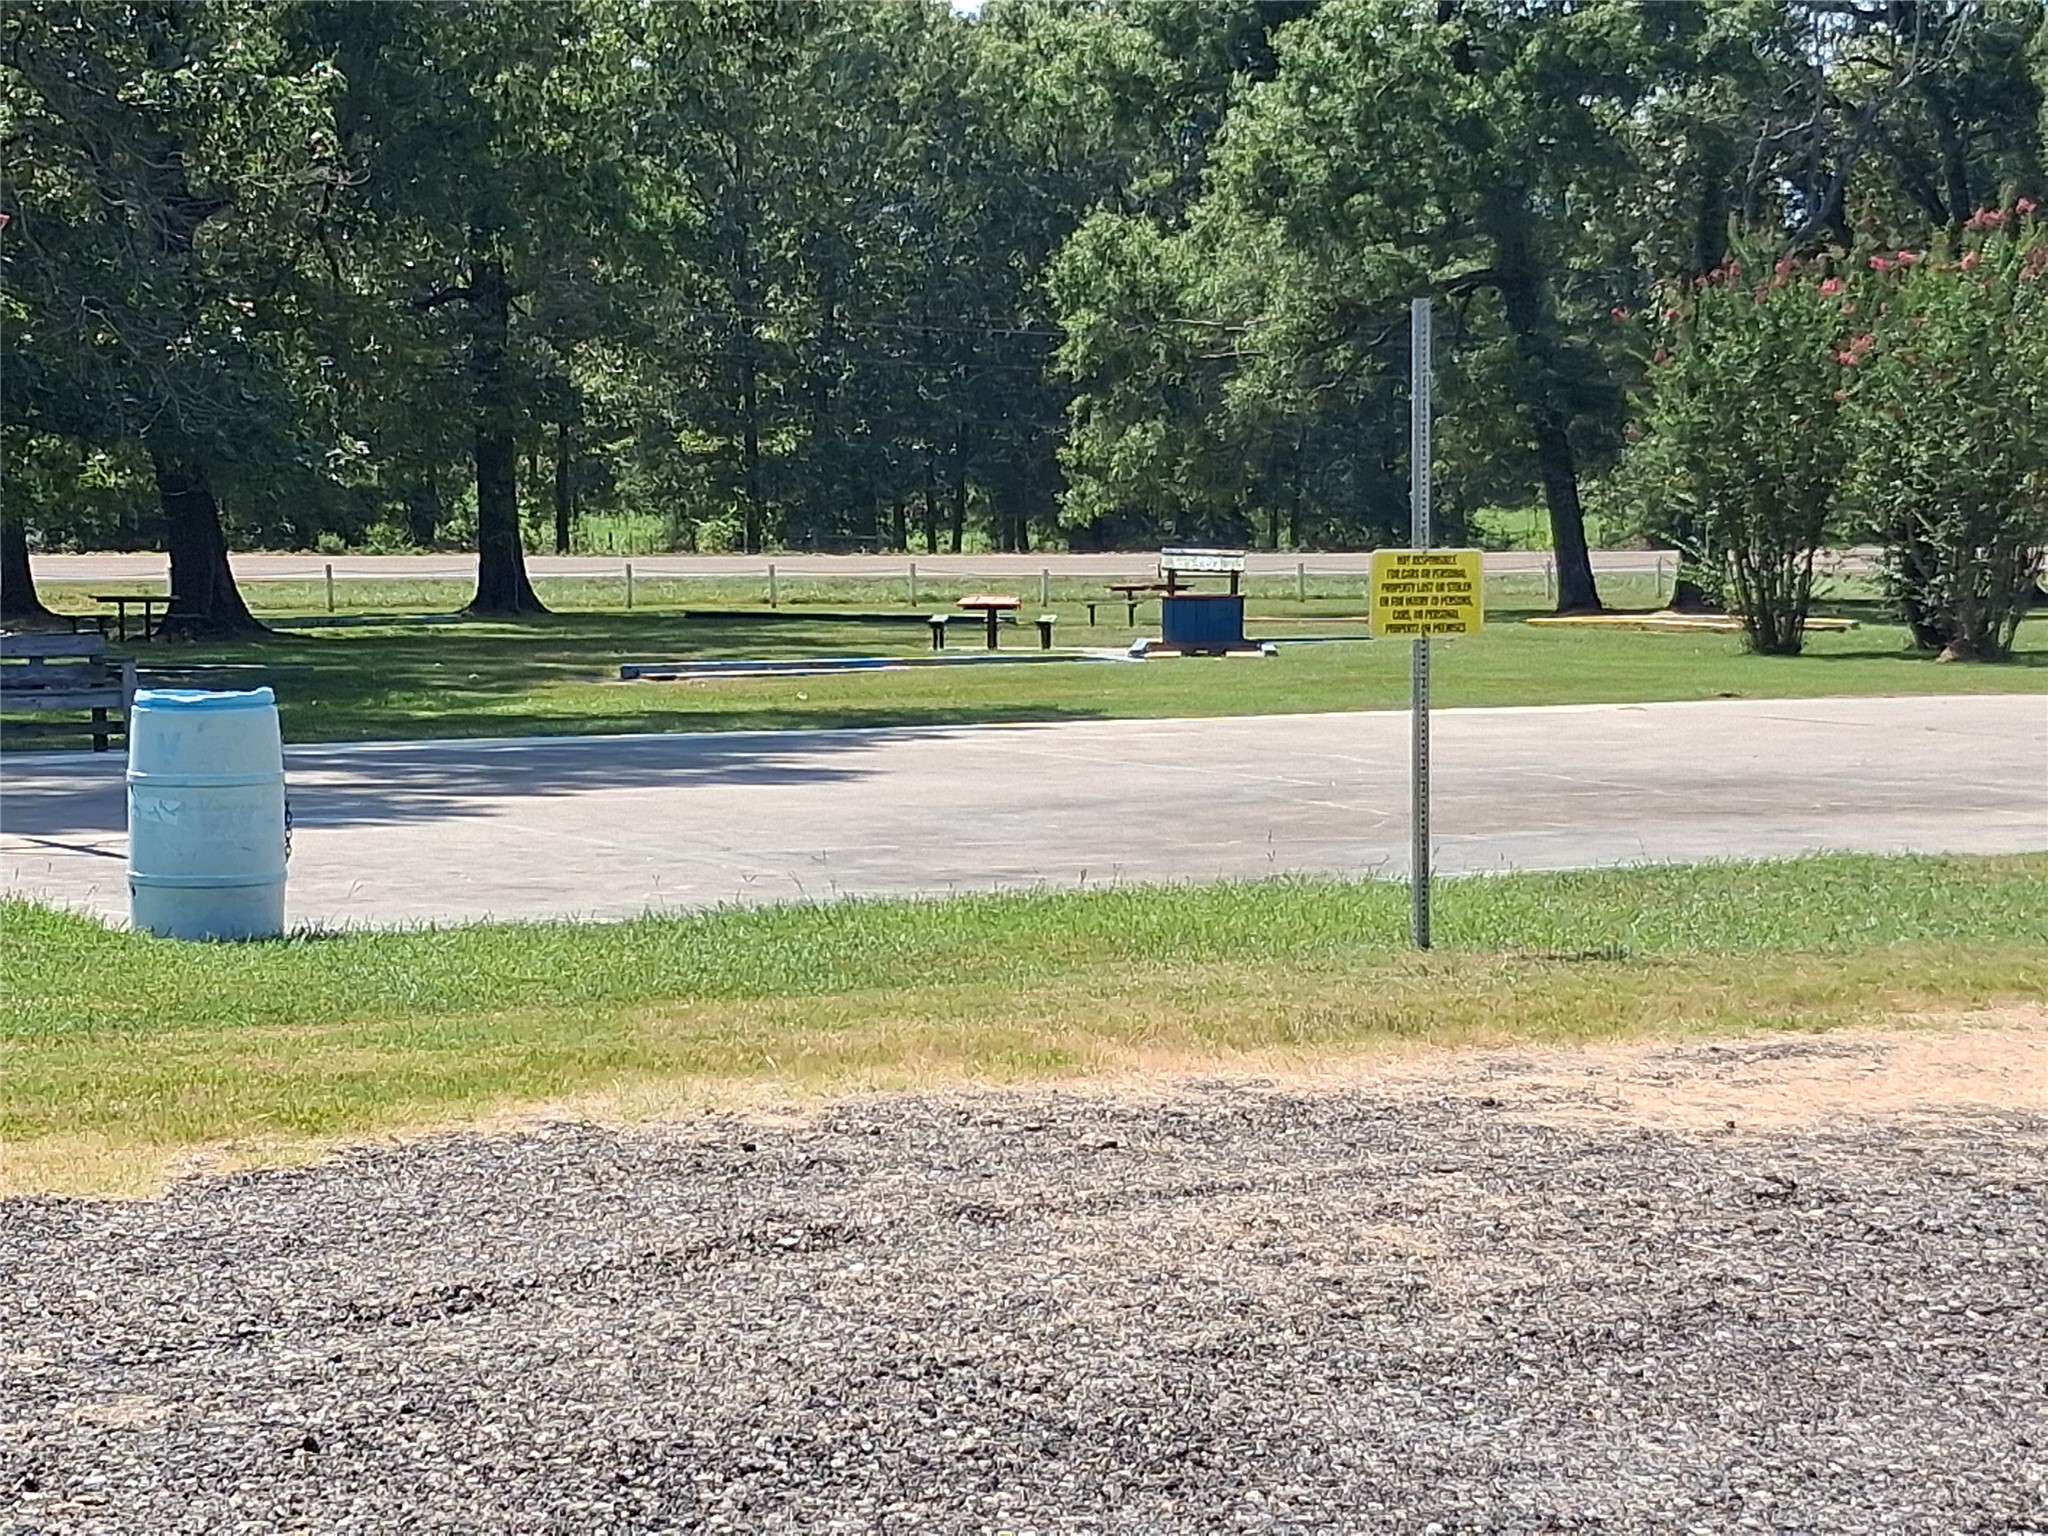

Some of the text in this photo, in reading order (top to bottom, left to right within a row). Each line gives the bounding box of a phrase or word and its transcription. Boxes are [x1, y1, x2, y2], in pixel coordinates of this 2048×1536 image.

[1397, 555, 1457, 565] NOT RESPONSIBLE
[1387, 569, 1400, 579] FOR
[1402, 569, 1419, 579] CARS
[1381, 583, 1415, 593] PROPERTY
[1417, 582, 1434, 592] LOST
[1447, 582, 1471, 592] STOLEN
